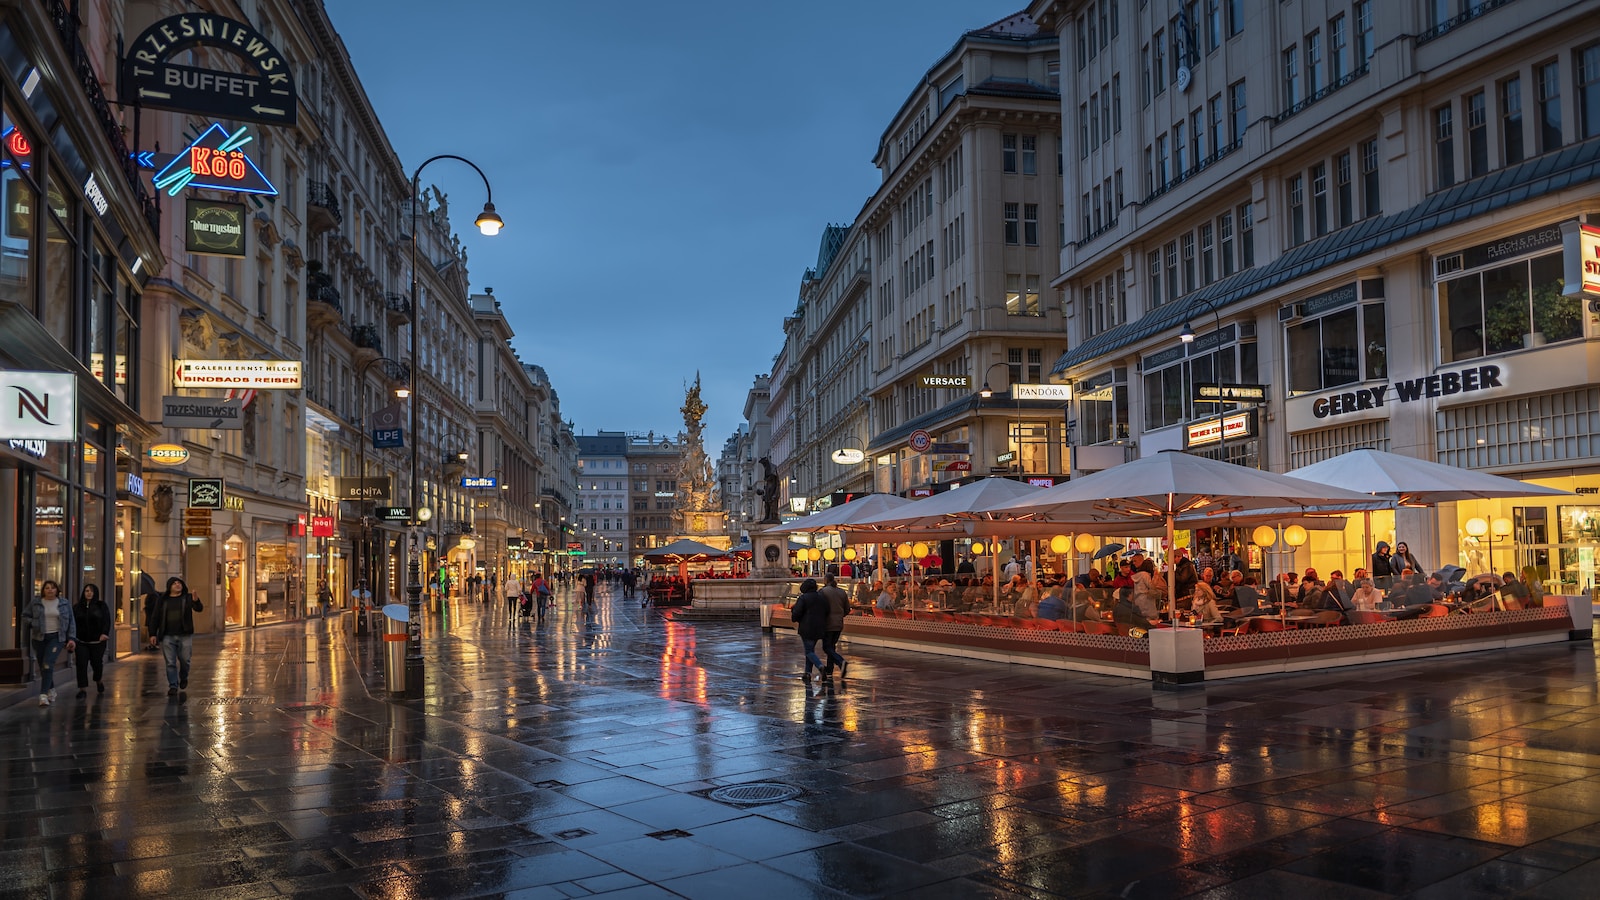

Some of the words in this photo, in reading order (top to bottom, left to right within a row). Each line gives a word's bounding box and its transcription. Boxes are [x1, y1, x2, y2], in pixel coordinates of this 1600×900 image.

[134, 17, 289, 96] TRZEŚNIEWSKI
[165, 68, 259, 97] BUFFET
[191, 147, 245, 180] Köö
[190, 220, 209, 231] blue
[1488, 240, 1518, 255] PLECH
[1520, 237, 1526, 245] &
[1528, 228, 1560, 243] PLECH
[923, 377, 967, 385] VERSACE
[1231, 388, 1263, 397] WEBER
[1313, 385, 1388, 419] GERRY
[1395, 364, 1503, 403] WEBER
[166, 403, 238, 418] TRZEŚNIEWSKI
[377, 430, 399, 440] LPE
[128, 472, 144, 497] FOSSIL
[390, 508, 406, 516] IWC
